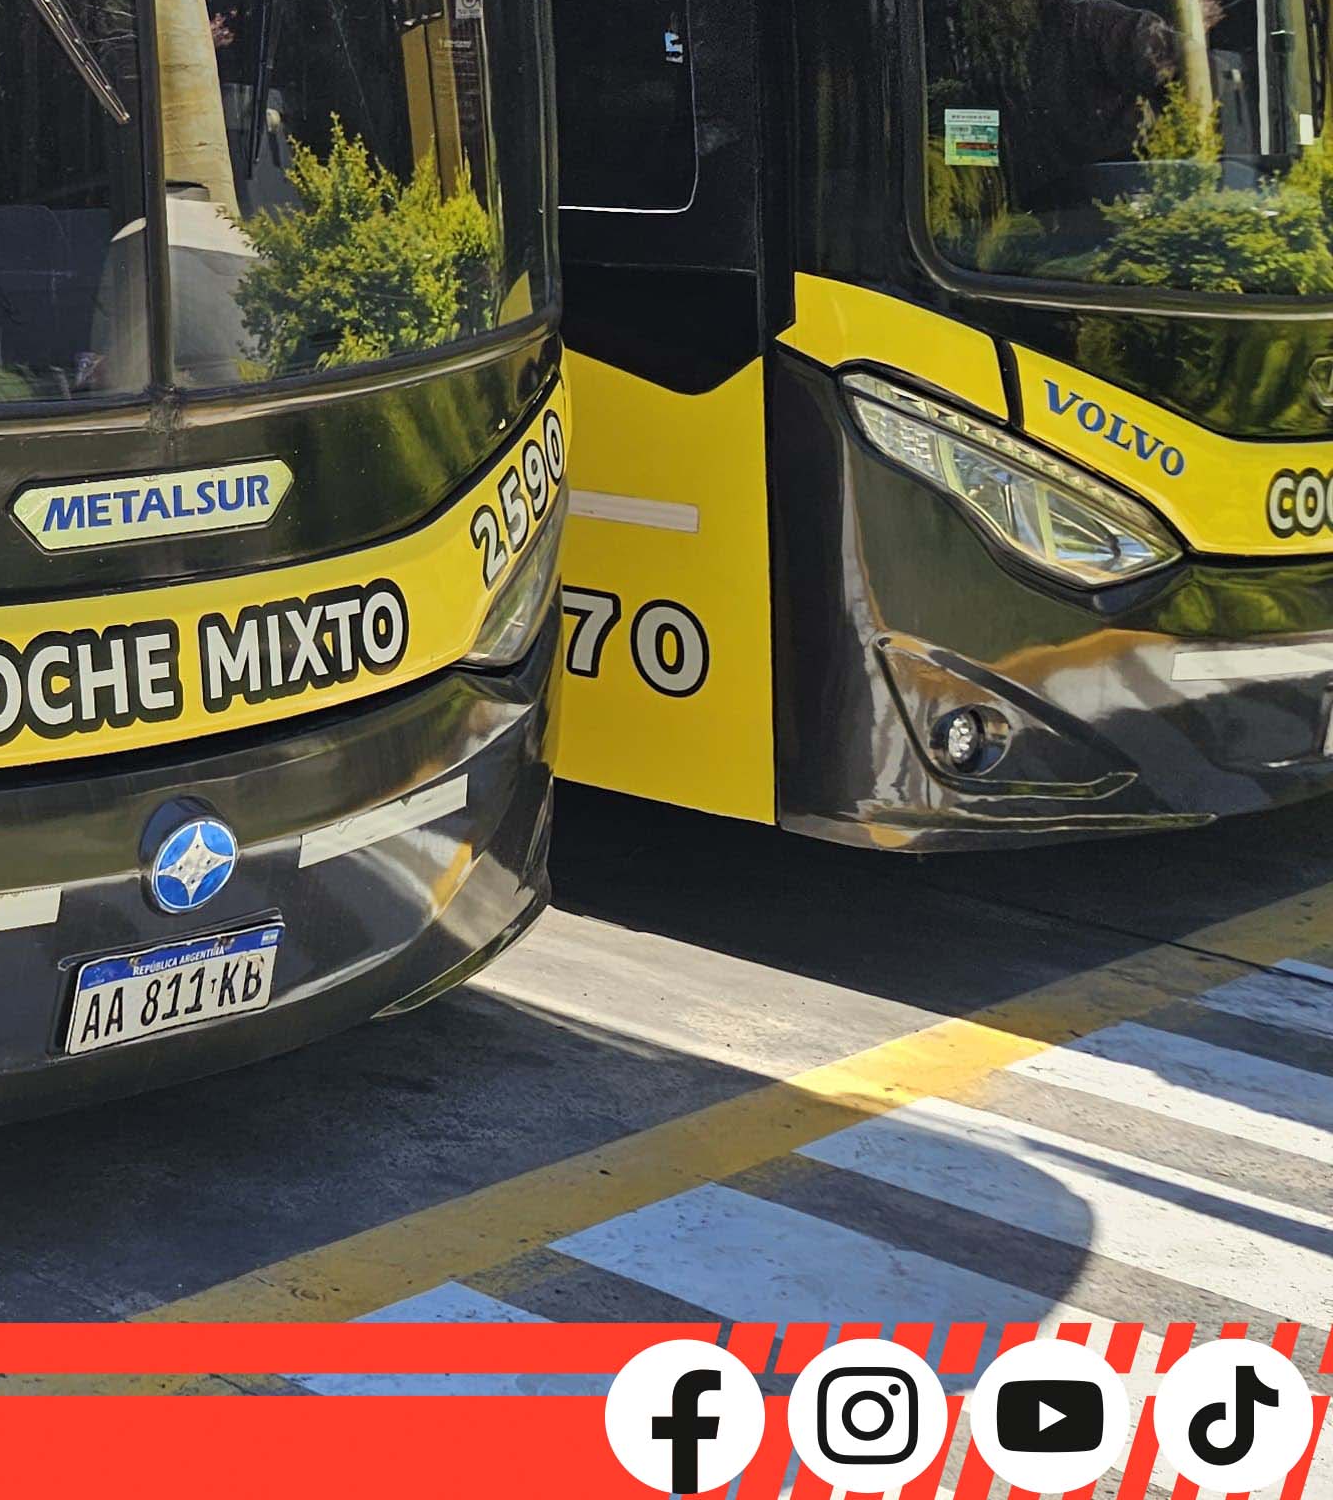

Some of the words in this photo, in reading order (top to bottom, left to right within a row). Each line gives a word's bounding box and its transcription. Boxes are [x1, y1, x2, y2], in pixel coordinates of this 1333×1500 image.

[1043, 379, 1185, 477] VOLVO
[41, 473, 271, 534] METALSUR
[469, 408, 567, 590] 2590
[198, 577, 410, 713] MIXTO
[80, 986, 124, 1044] AA
[140, 966, 206, 1027] 811
[133, 956, 178, 977] REPÚBLICA
[180, 945, 225, 966] ARGENTINA
